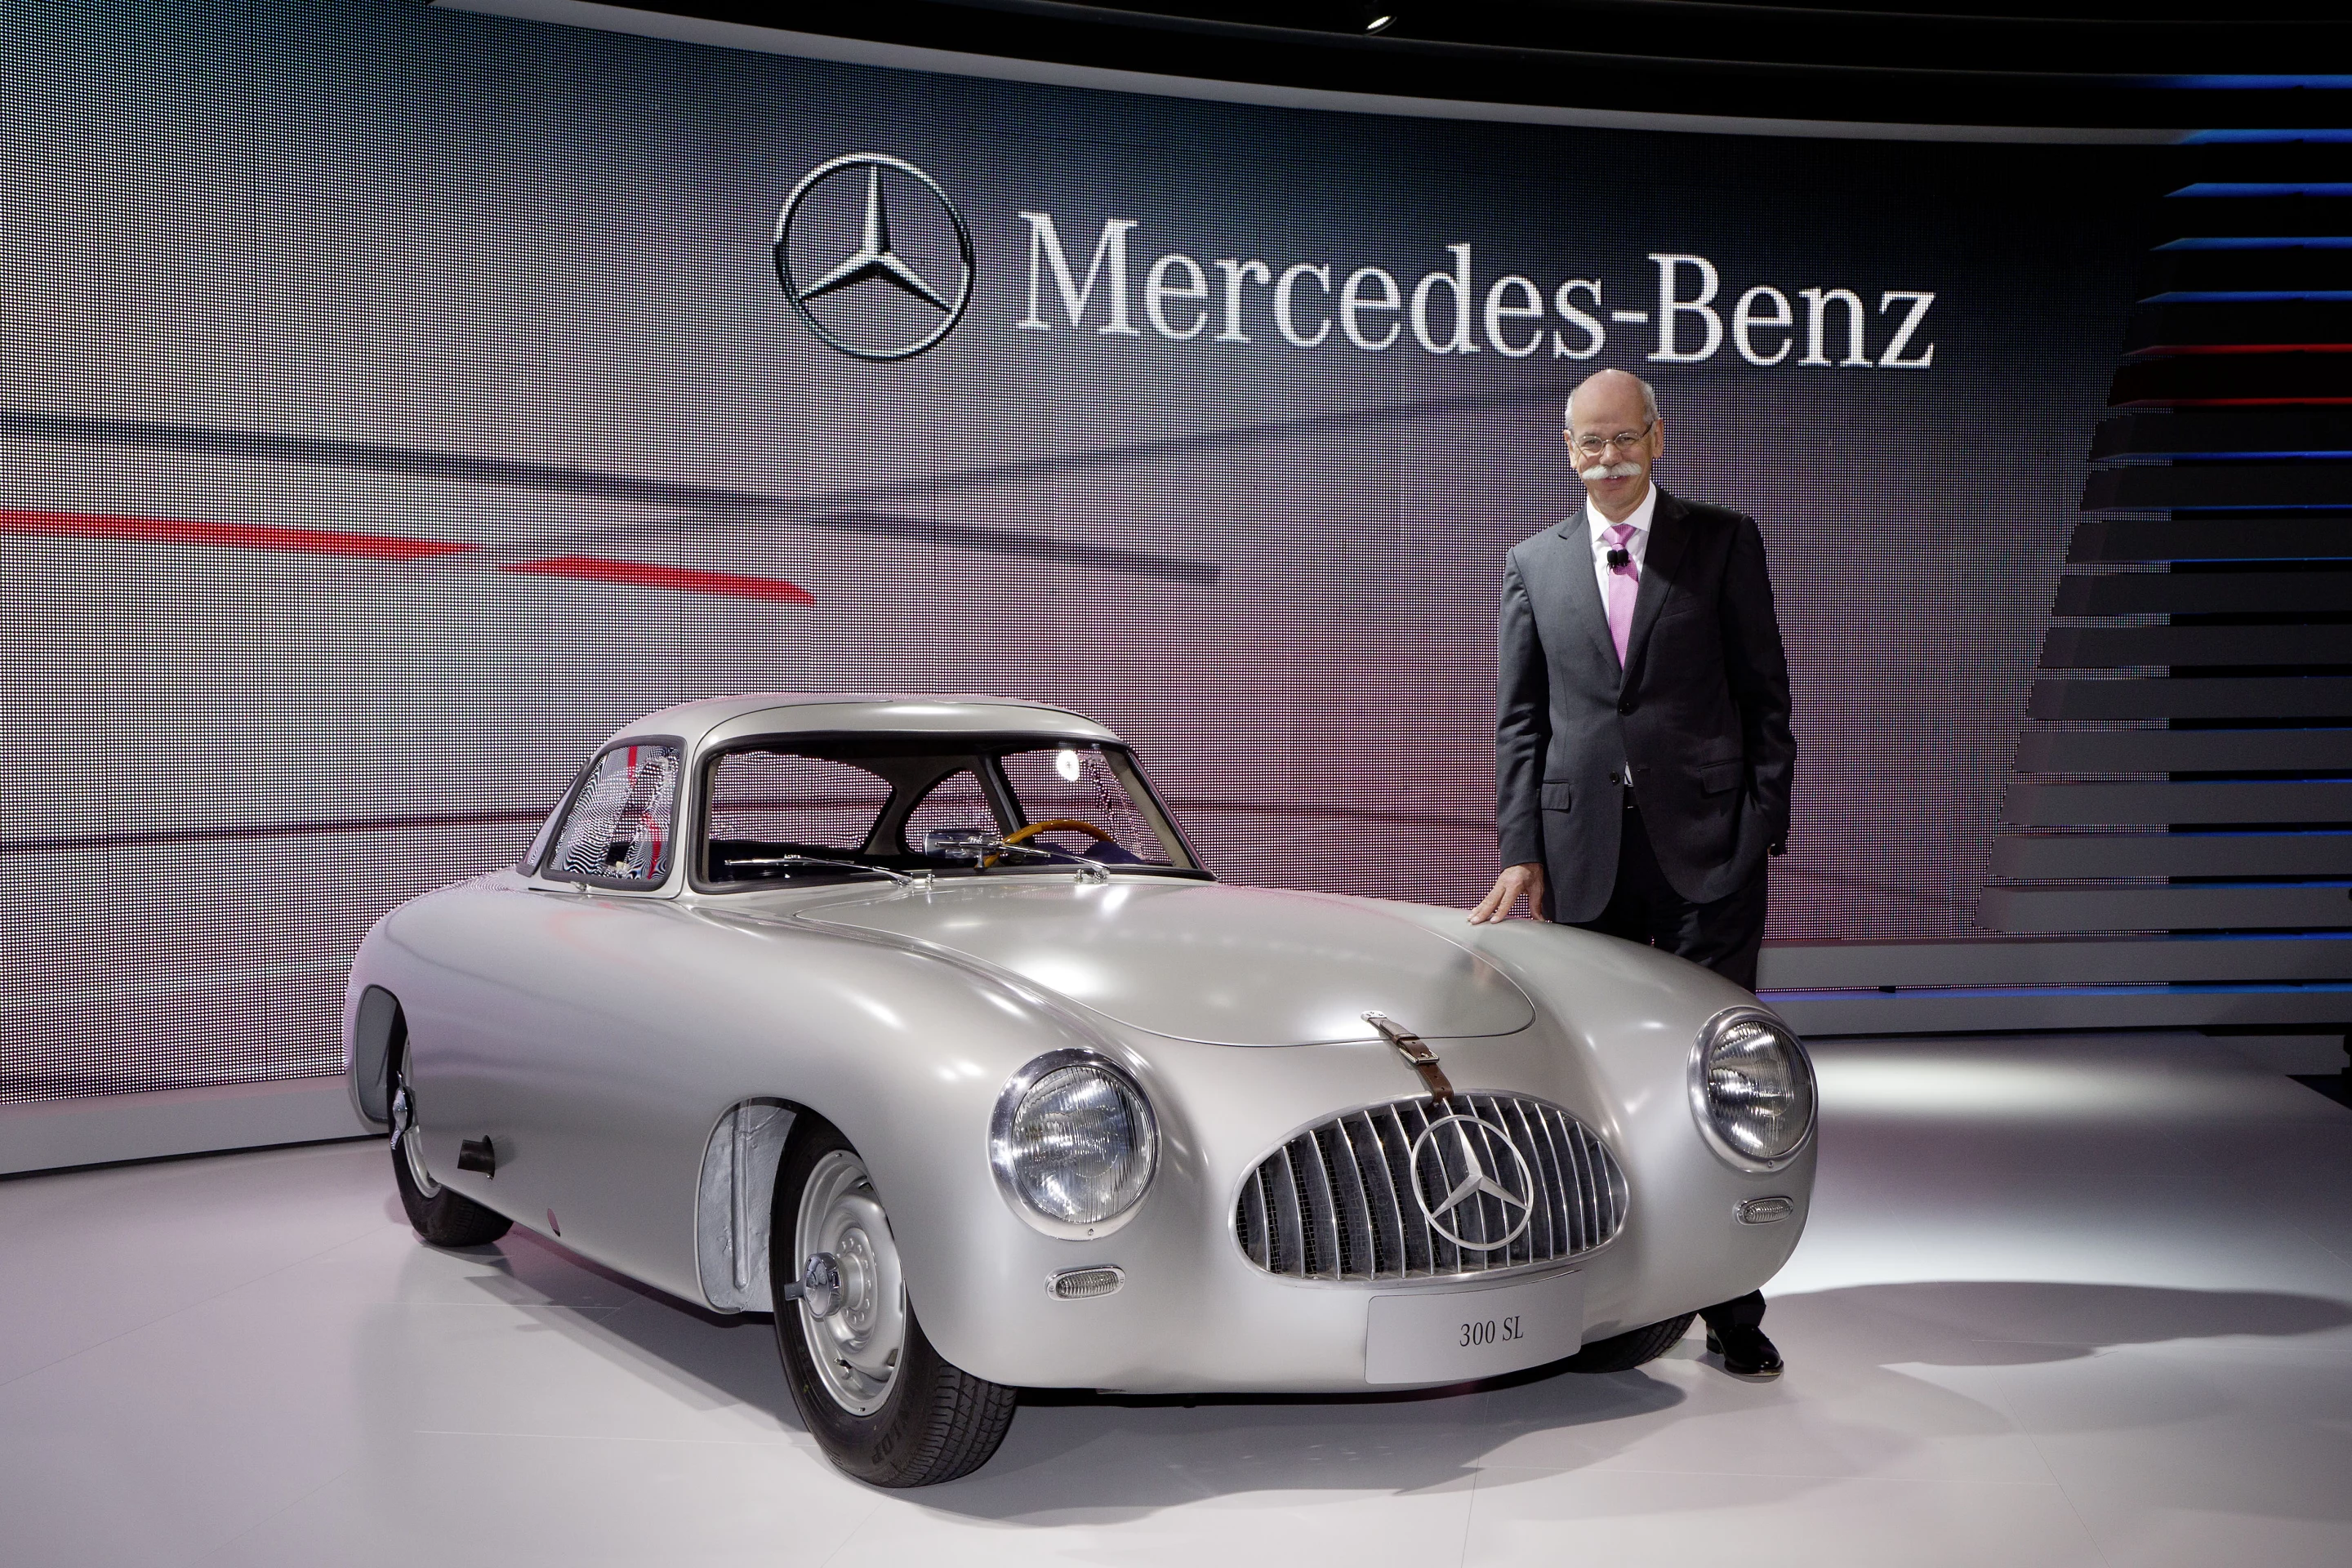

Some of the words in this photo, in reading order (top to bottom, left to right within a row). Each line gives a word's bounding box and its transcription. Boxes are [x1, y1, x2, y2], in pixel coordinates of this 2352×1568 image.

[1017, 211, 1936, 370] Mercedes-Benz
[1459, 1320, 1496, 1347] 300
[1502, 1315, 1524, 1342] SL
